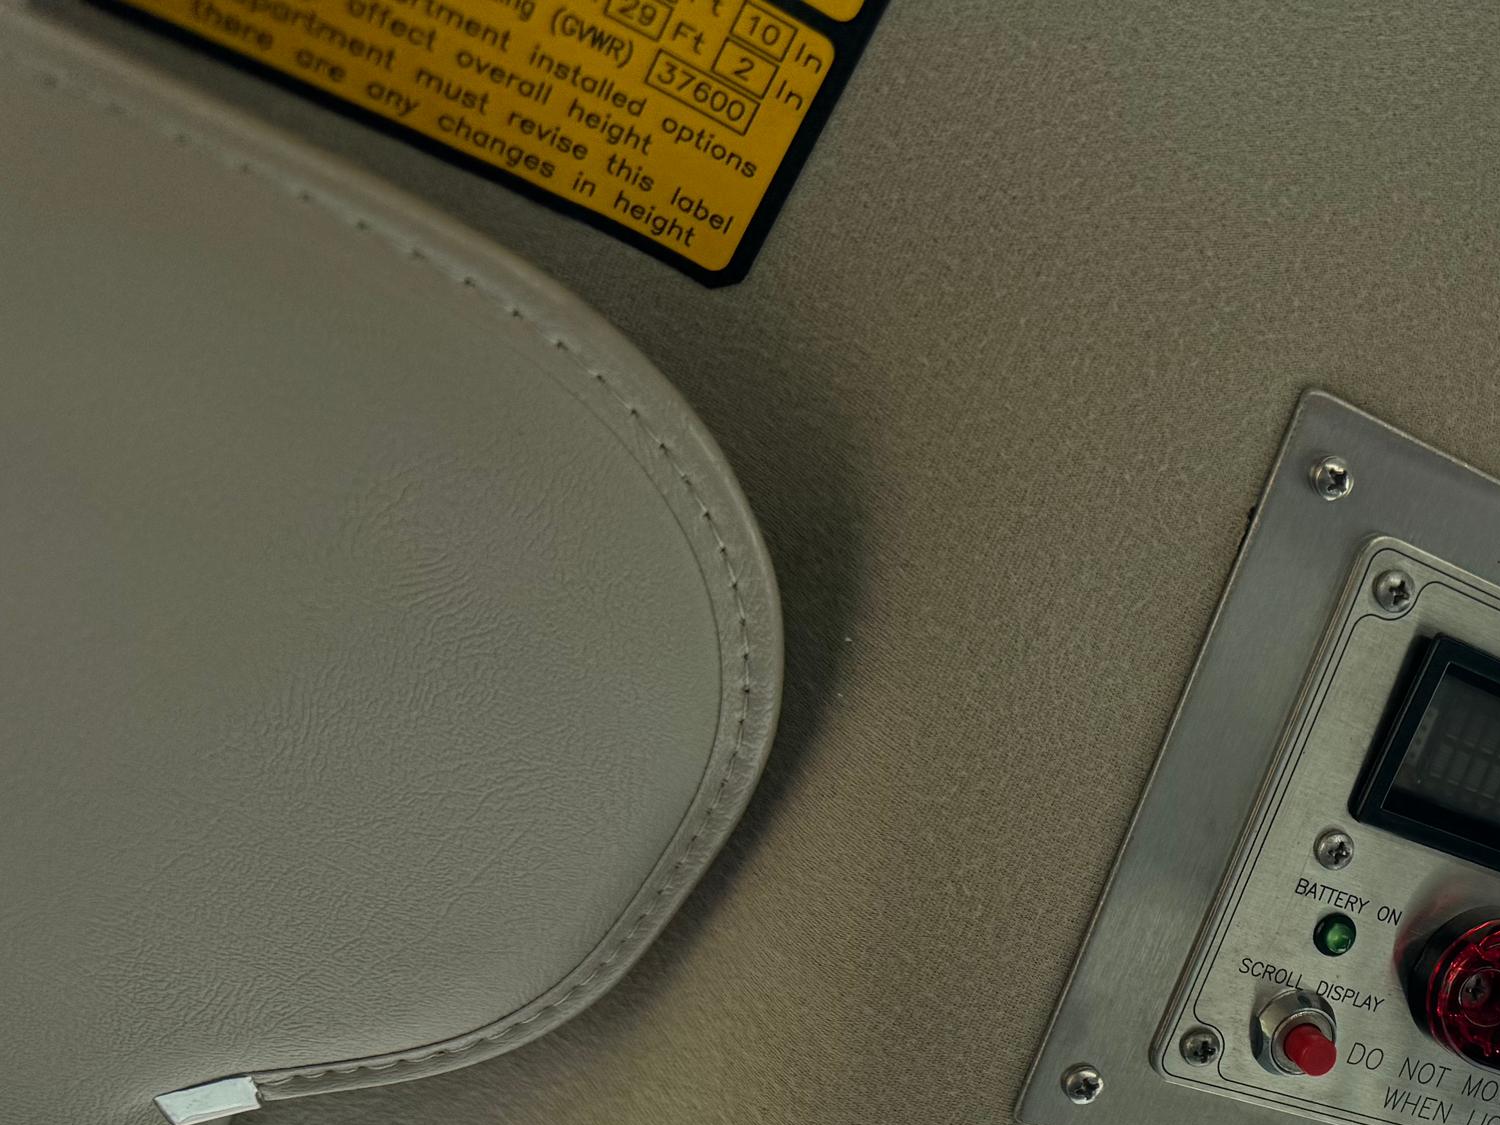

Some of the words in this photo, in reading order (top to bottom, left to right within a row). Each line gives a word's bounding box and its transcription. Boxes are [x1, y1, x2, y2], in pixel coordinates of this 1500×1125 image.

[551, 7, 634, 68] (GVWR)
[657, 61, 746, 122] 37600
[617, 0, 657, 26] 29
[671, 25, 706, 55] Ft
[733, 57, 754, 81] 2
[775, 80, 804, 112] In
[749, 15, 782, 47] 10
[794, 44, 823, 75] In
[296, 48, 346, 83] are
[366, 79, 419, 117] any
[437, 112, 556, 179] changes
[572, 172, 597, 198] in
[613, 191, 697, 249] height
[416, 67, 491, 115] must
[508, 111, 588, 161] revise
[607, 153, 654, 193] this
[671, 187, 734, 235] label
[456, 51, 554, 105] overall
[568, 98, 653, 156] height
[529, 45, 648, 118] installed
[661, 116, 758, 179] options
[1294, 878, 1370, 914] BATTERY
[1377, 905, 1403, 927] ON
[1238, 958, 1304, 991] SCROLL
[1316, 980, 1385, 1013] DISPLAY
[1347, 1042, 1384, 1071] DO
[1398, 1057, 1451, 1088] NOT
[1383, 1086, 1454, 1124] WHEN
